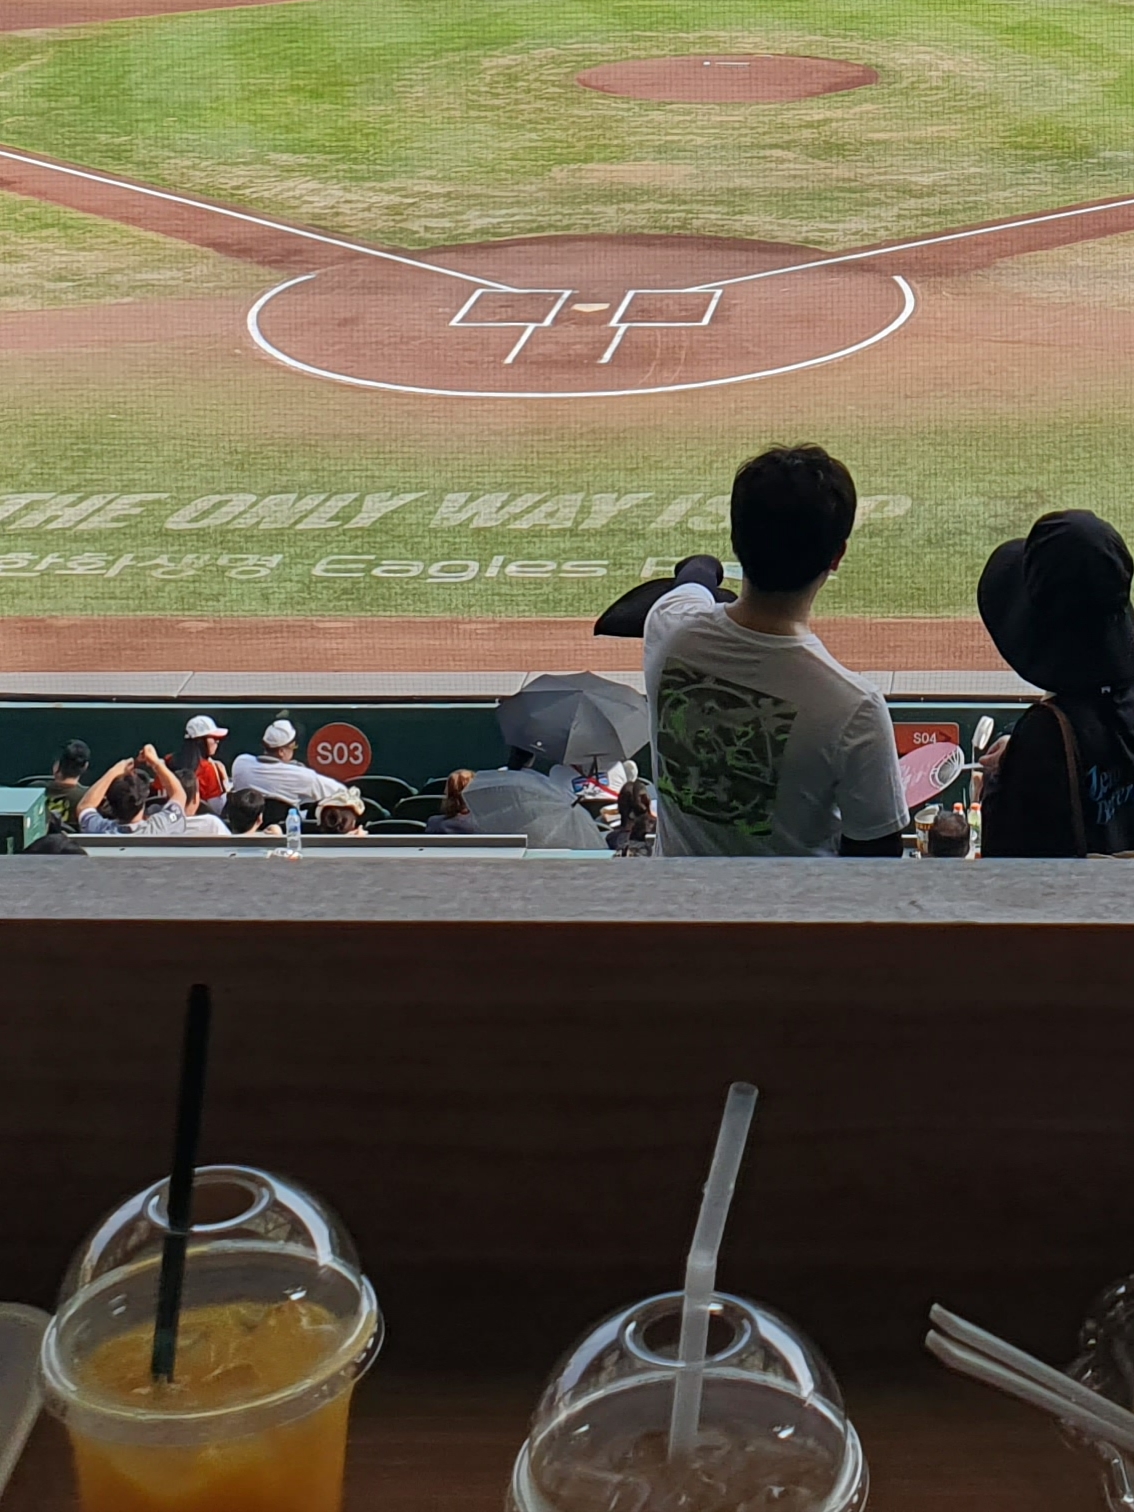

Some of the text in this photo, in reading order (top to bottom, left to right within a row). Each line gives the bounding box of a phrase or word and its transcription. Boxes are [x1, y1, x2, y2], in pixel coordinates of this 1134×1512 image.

[164, 491, 428, 531] ONLY
[428, 491, 654, 530] WAY
[311, 555, 608, 583] Eagles
[912, 732, 938, 745] S04
[316, 741, 365, 766] S03
